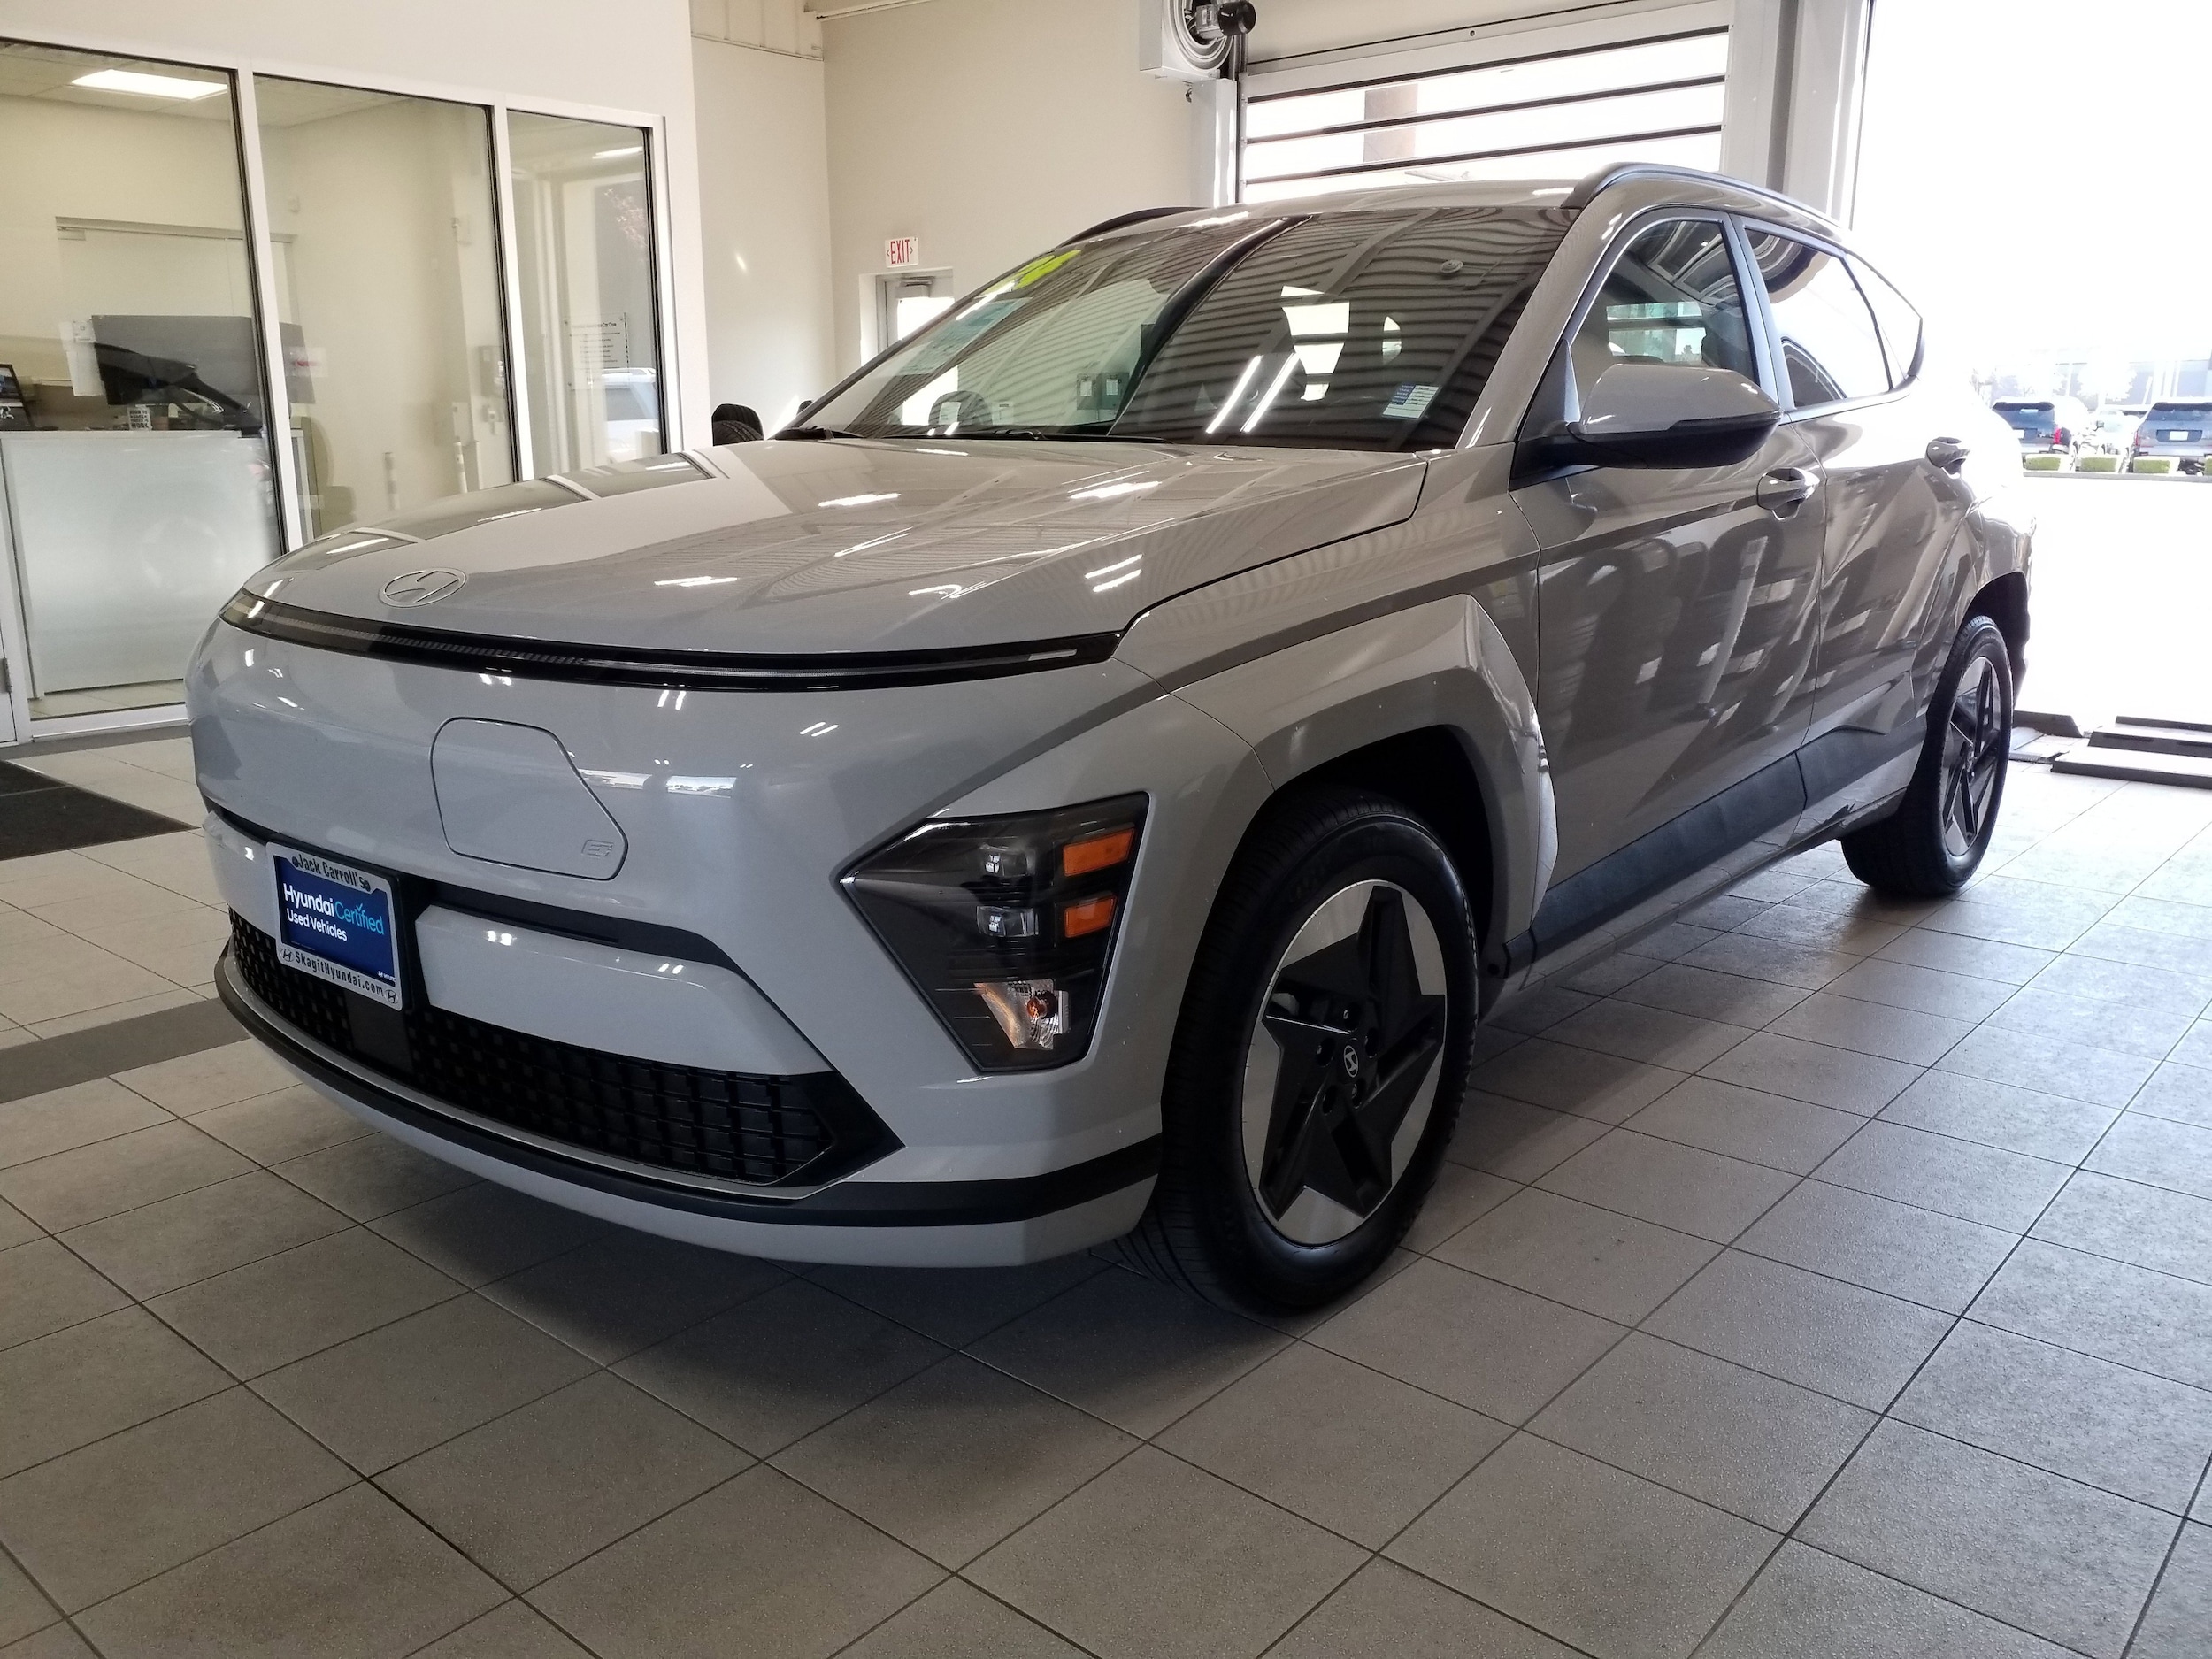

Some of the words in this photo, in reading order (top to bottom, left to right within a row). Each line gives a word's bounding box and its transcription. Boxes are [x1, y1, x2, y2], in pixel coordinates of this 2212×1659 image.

[890, 239, 910, 264] EXIT
[298, 854, 321, 873] Jack
[322, 861, 365, 888] Carroll's
[283, 883, 335, 917] Hyundai
[334, 901, 385, 935] Certified
[287, 908, 310, 928] Used
[310, 916, 348, 941] Vehicles
[296, 951, 384, 997] SkagitHyundai.com
